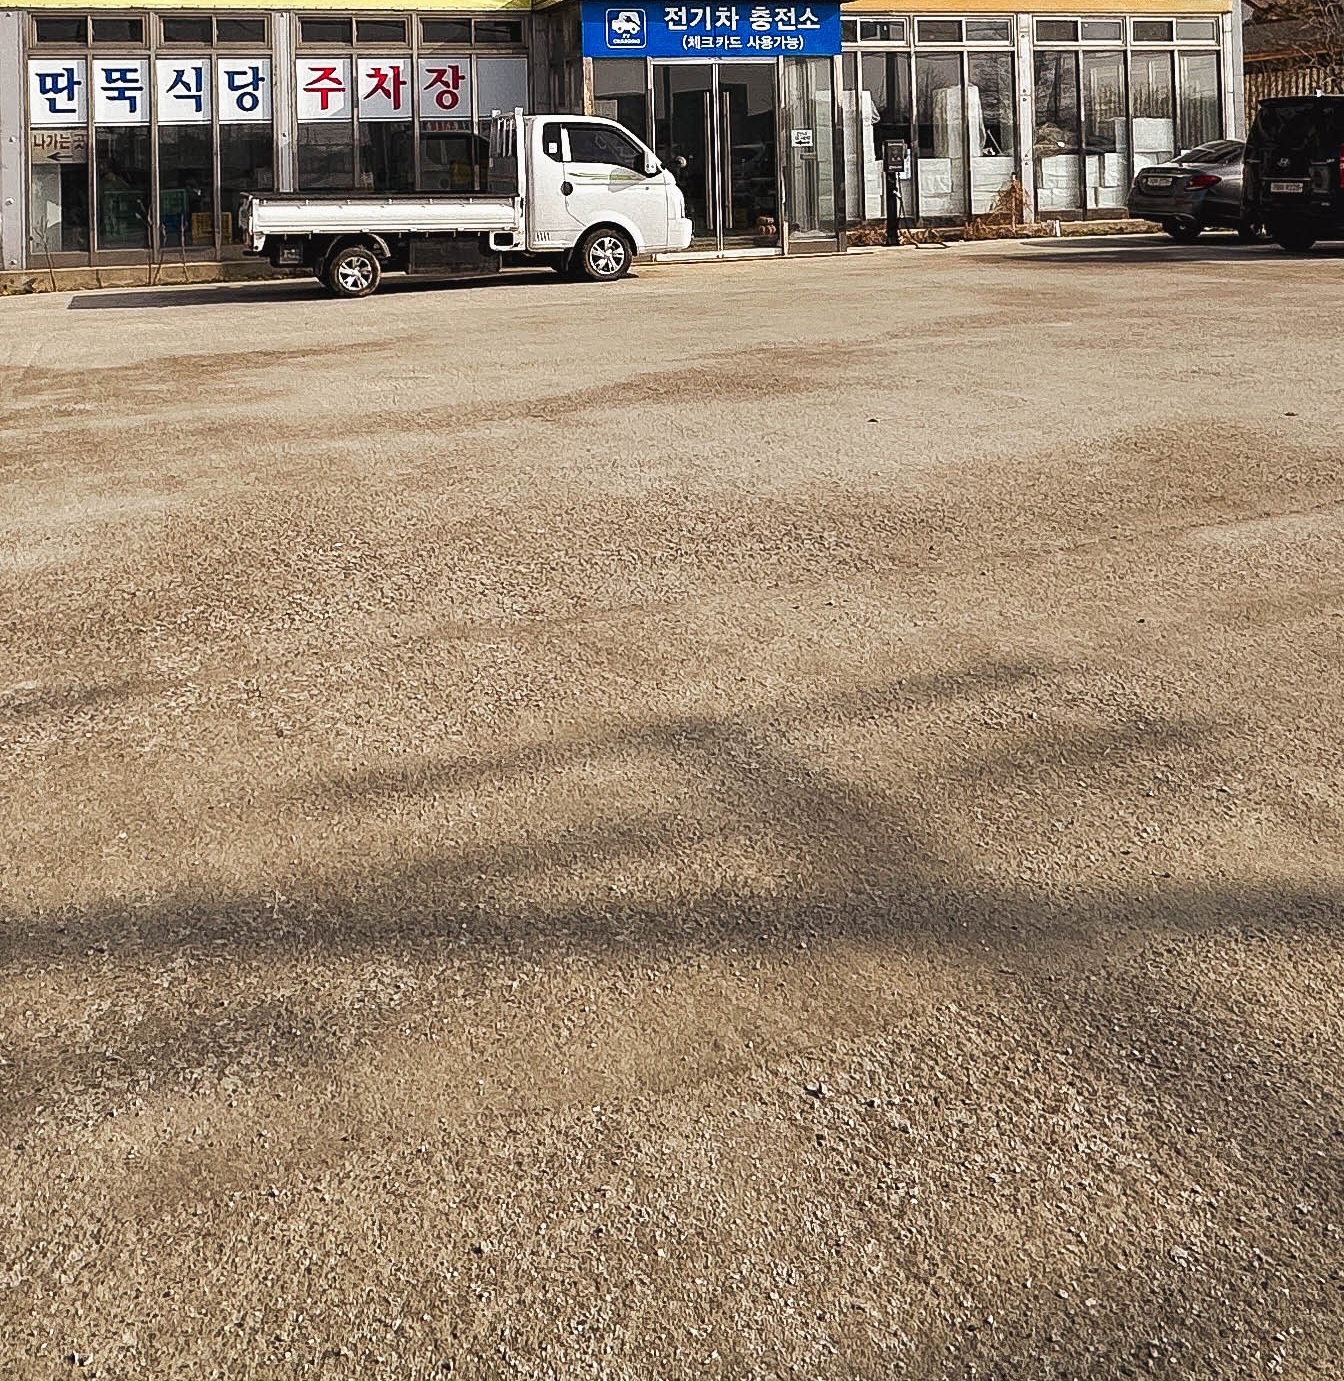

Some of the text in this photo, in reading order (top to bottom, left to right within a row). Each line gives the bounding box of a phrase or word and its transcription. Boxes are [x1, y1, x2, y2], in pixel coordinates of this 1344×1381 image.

[663, 5, 821, 31] 전기차 충전소
[682, 34, 804, 50] (체크카드 사용가능)
[35, 64, 466, 116] 딴뚝식당 주차장
